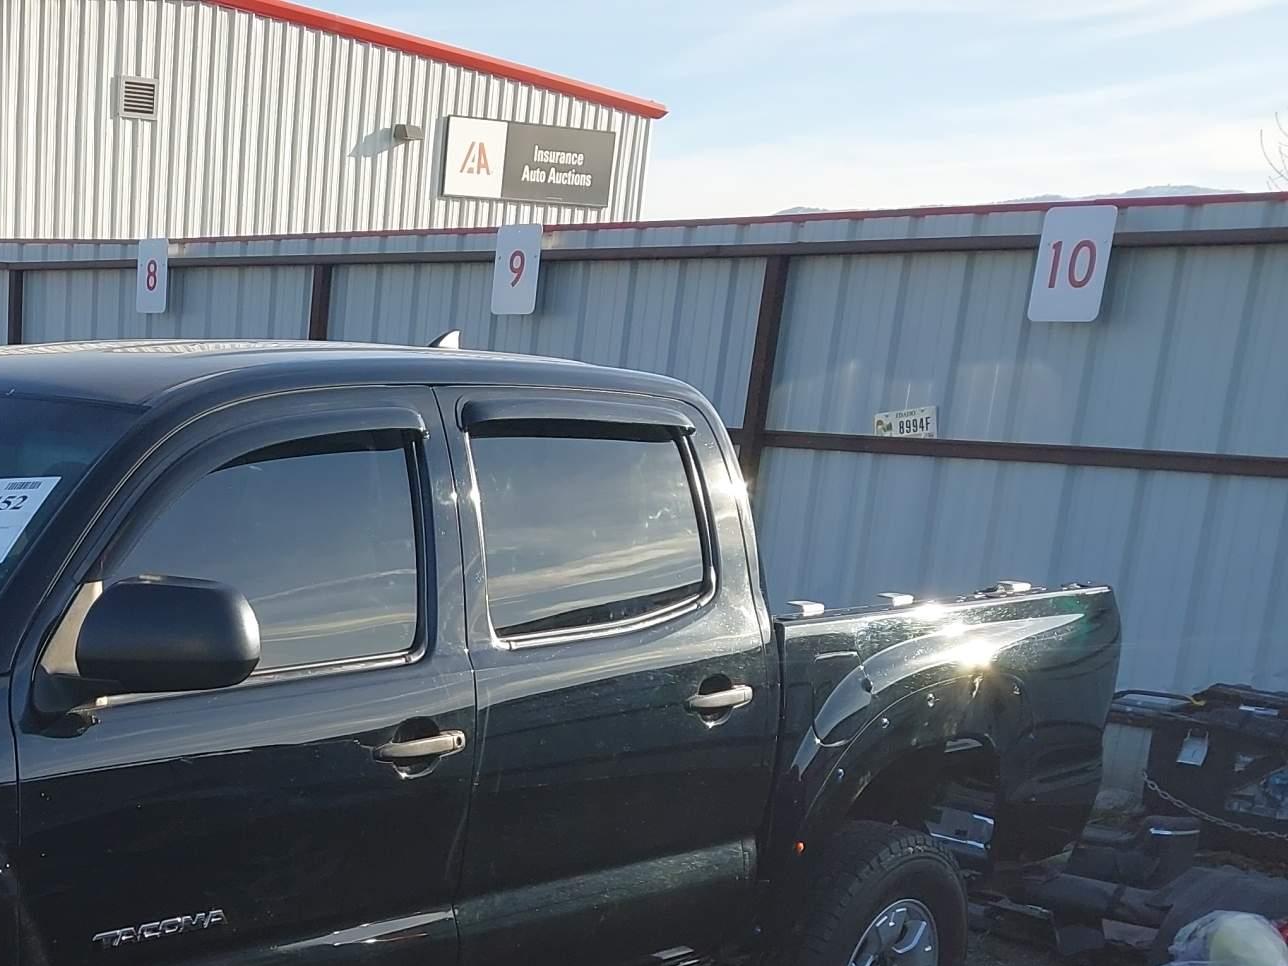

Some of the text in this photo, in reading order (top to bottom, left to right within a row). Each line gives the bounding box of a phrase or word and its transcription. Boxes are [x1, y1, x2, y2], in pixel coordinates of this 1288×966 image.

[533, 144, 585, 166] Insurance
[521, 165, 593, 187] Auto Auctions
[146, 259, 158, 292] 8
[509, 249, 526, 288] 9
[1048, 239, 1097, 289] 10
[899, 416, 931, 434] 8994F
[92, 909, 227, 950] TACOMA
